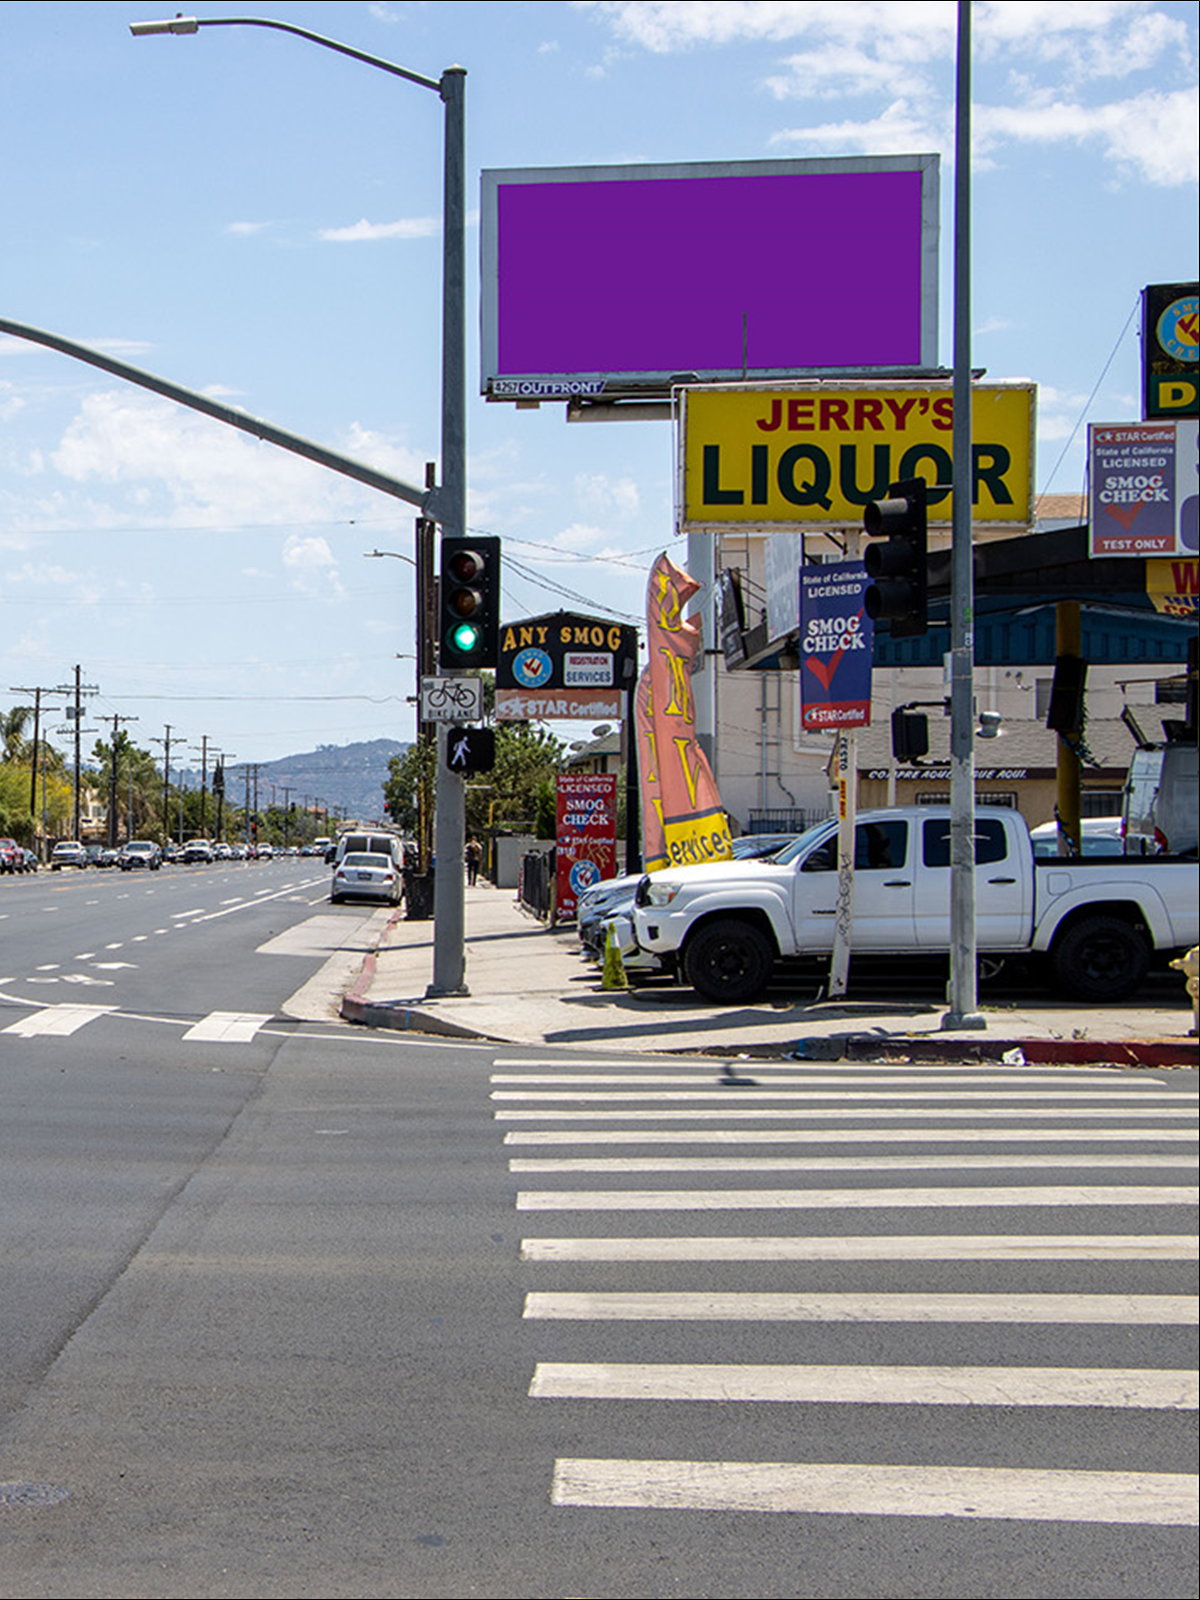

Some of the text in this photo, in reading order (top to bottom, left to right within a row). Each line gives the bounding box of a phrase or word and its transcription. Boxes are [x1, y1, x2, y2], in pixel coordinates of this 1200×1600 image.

[521, 382, 602, 394] OUTFRONT
[756, 397, 953, 432] JERRY'S
[1115, 432, 1139, 441] STAR
[1096, 448, 1118, 456] State
[1132, 446, 1173, 455] California
[1103, 458, 1166, 468] LICENSED
[702, 443, 1014, 512] LIQUOR
[1105, 475, 1163, 489] SMOG
[1099, 489, 1170, 503] CHECK
[1103, 539, 1165, 549] TEST ONLY
[808, 584, 862, 598] LICENSED
[808, 616, 860, 636] SMOG
[502, 626, 621, 652] ANY SMOG
[803, 633, 866, 653] CHECK
[566, 672, 611, 683] SERVICES
[527, 701, 617, 715] STAR Certified
[819, 710, 838, 722] STAR
[560, 784, 612, 794] LICENSED
[566, 798, 605, 811] SMOG
[562, 813, 609, 826] CHECK
